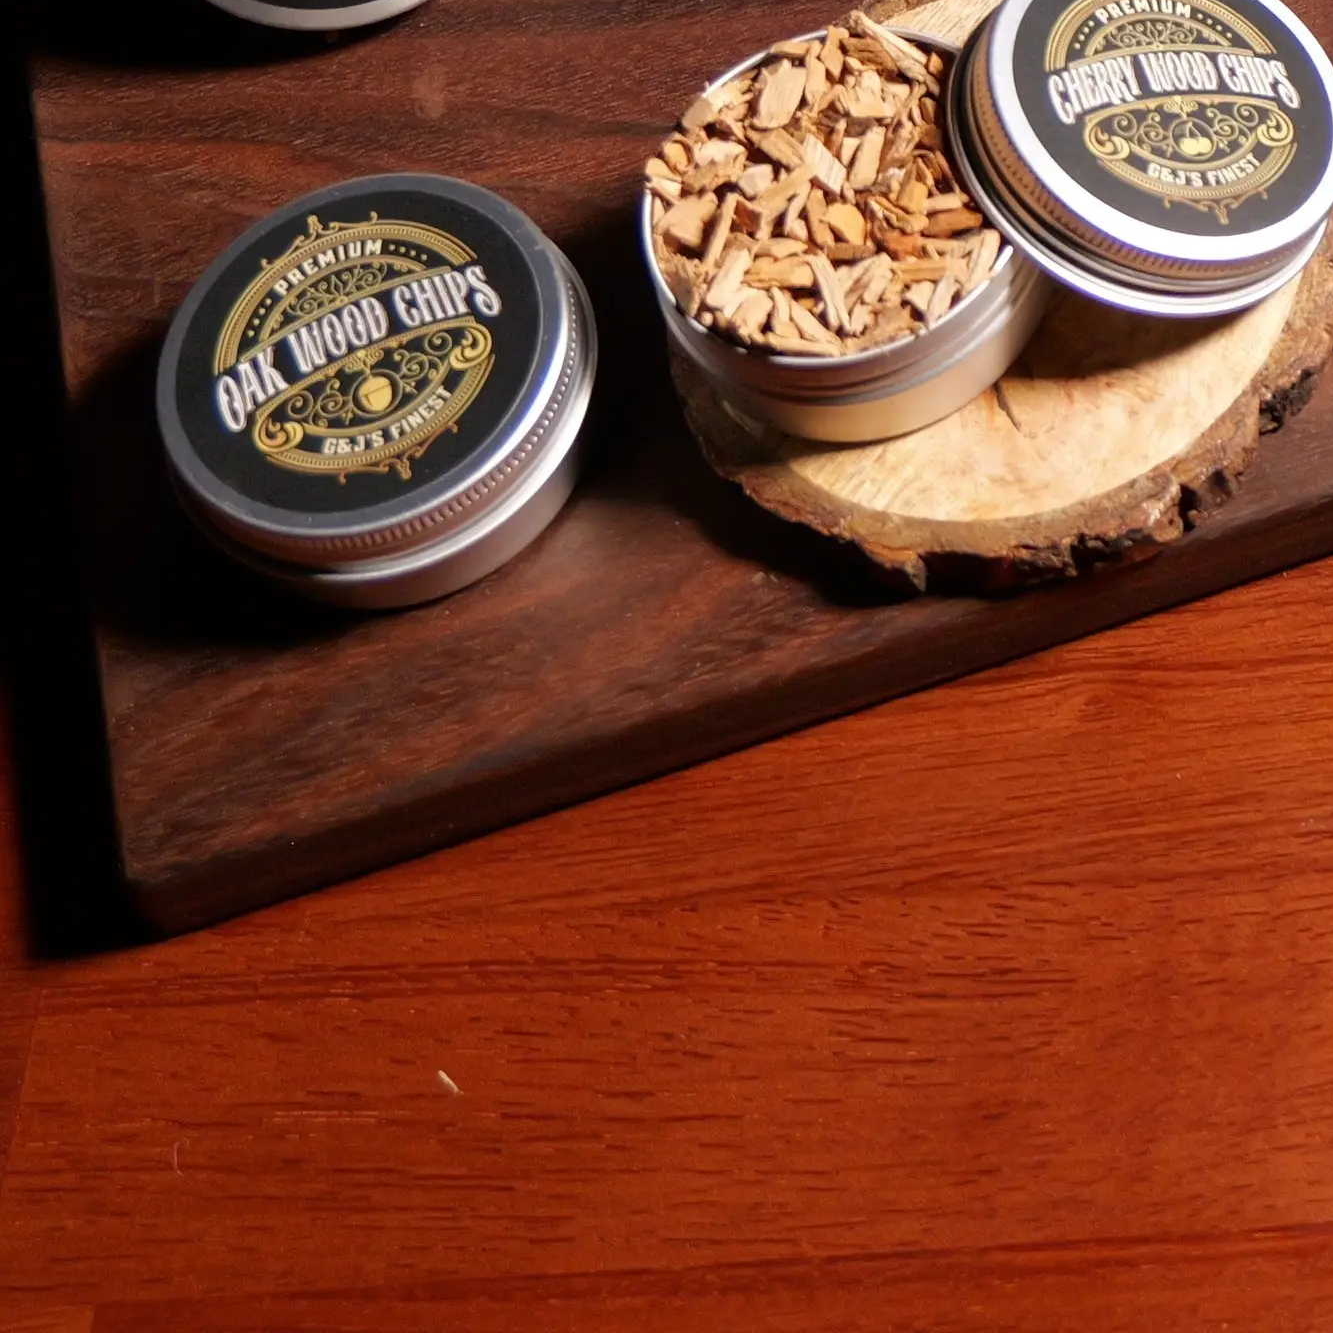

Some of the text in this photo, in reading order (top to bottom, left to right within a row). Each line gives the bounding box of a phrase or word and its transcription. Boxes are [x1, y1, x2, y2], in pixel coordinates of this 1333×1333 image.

[1047, 51, 1301, 125] CHERRY WOOD CHIPS
[1146, 152, 1262, 186] G&J'S FINEST
[273, 238, 383, 299] PREMIUM
[216, 263, 502, 433] OAK WOOD CHIPS
[320, 384, 454, 456] G&J'S FINEST
